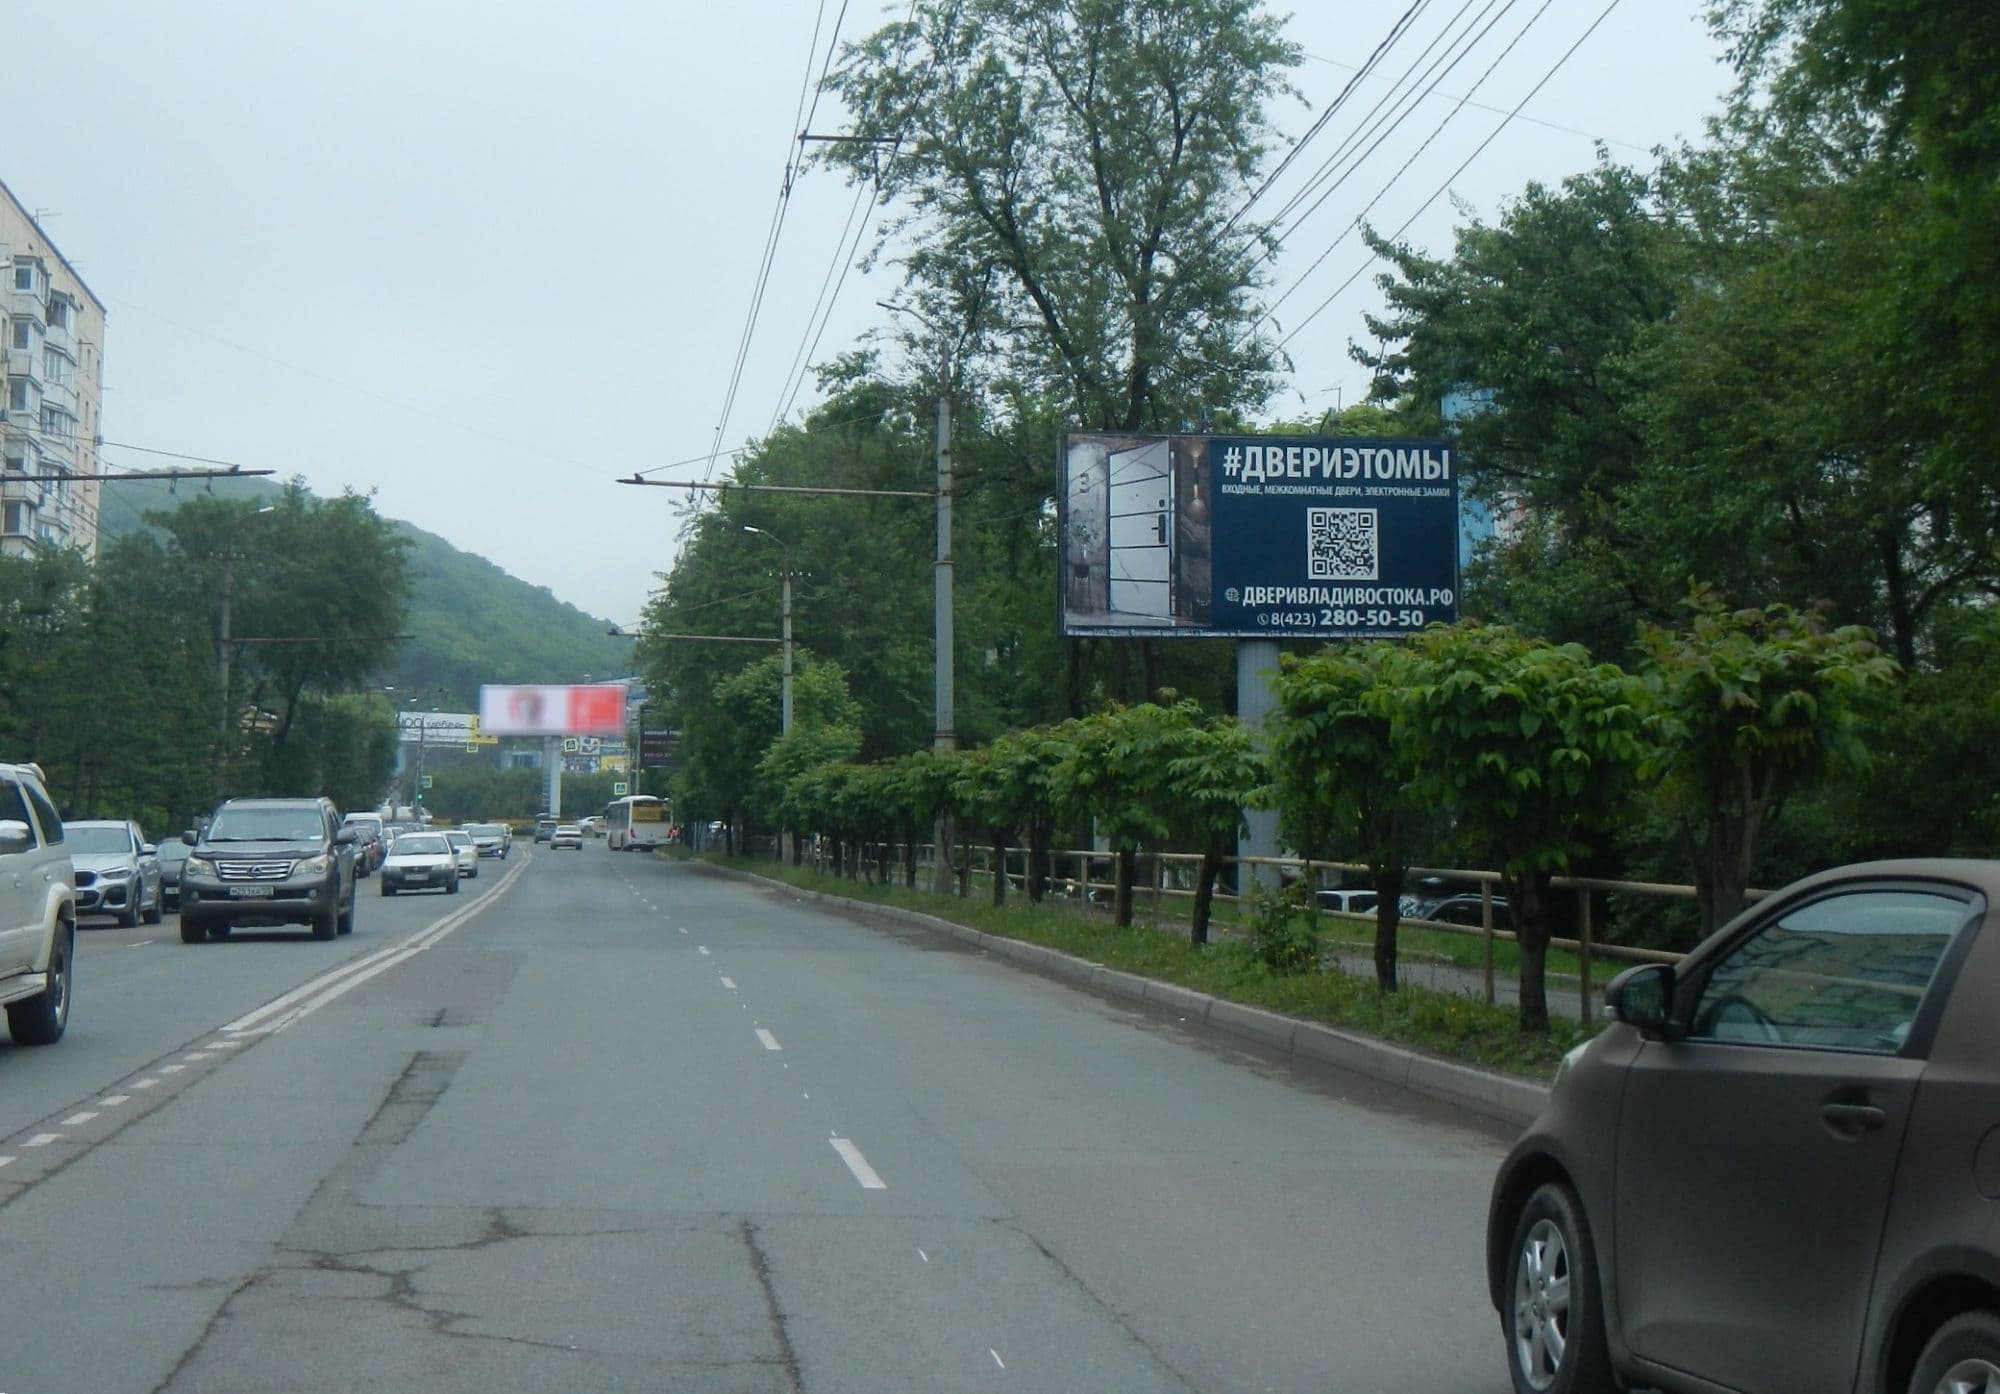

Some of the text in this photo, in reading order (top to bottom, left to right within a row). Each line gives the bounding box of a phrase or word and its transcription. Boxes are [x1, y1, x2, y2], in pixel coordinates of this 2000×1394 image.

[1223, 445, 1450, 482] #ДВЕРИЭТОМЫ
[1221, 484, 1263, 495] ВХОДНЫЕ,
[1334, 486, 1362, 497] ДВЕРИ,
[1364, 486, 1421, 497] ЭЛЕКТРОННЫЕ
[1423, 487, 1450, 497] ЗАМКИ
[1242, 587, 1454, 607] ДВЕРИВЛАДИВОСТОКА.РФ
[1270, 609, 1424, 627] 8(423) 280-50-50
